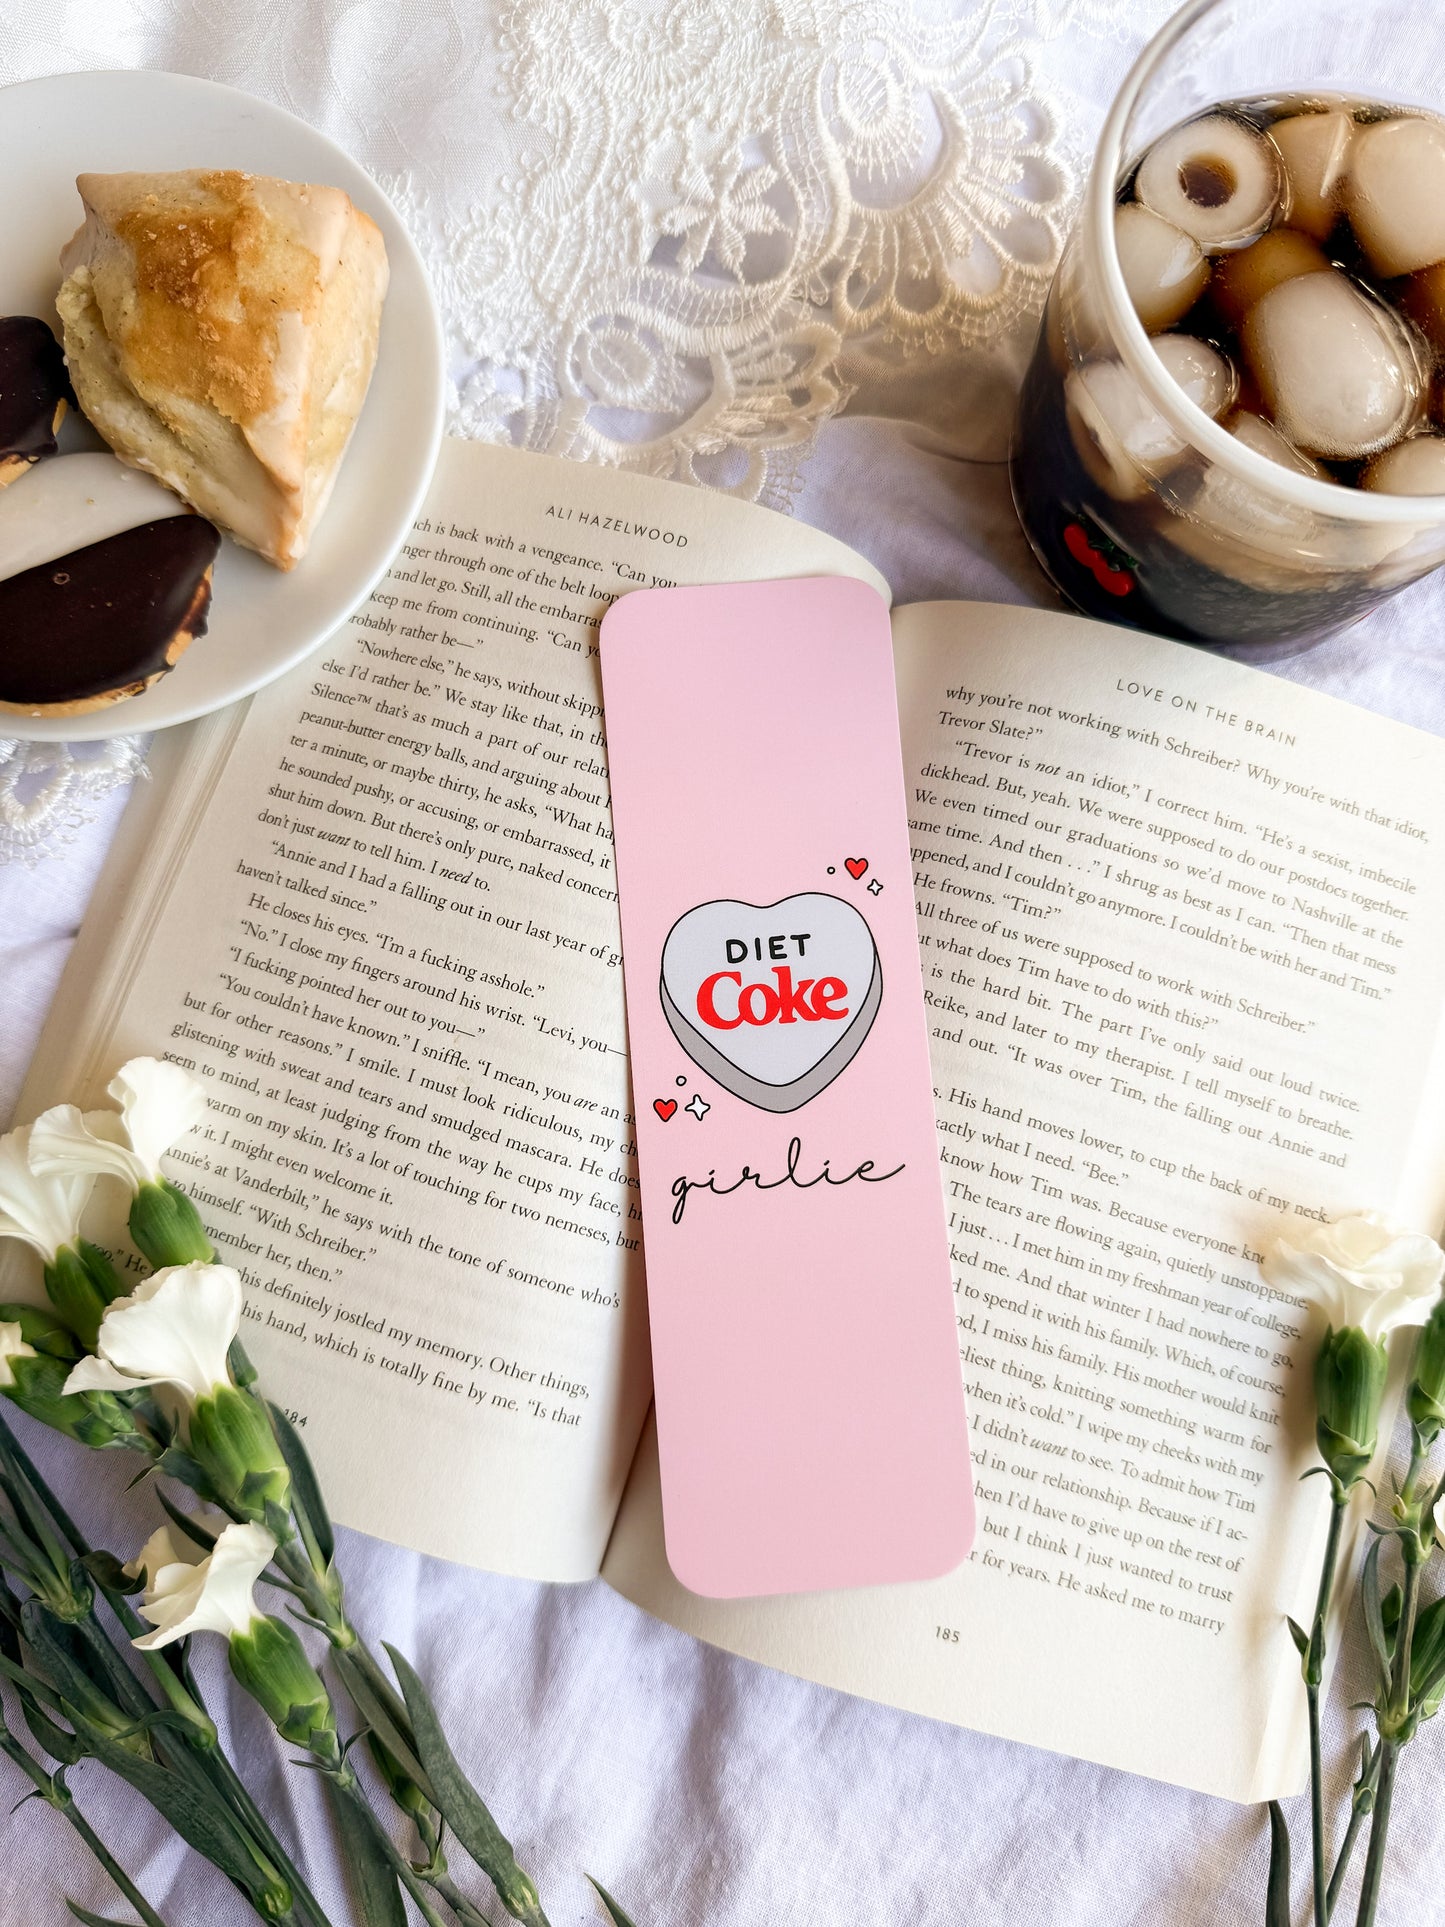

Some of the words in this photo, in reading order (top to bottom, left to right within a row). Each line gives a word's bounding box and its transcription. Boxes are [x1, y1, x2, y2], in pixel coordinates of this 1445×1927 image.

[434, 521, 445, 534] is
[449, 523, 478, 542] back
[485, 534, 514, 550] with
[518, 543, 526, 553] a
[532, 546, 603, 571] vengeance.
[611, 560, 645, 582] “Can
[545, 505, 572, 520] ALI
[578, 511, 687, 547] HAZELWOOD
[357, 639, 418, 665] “Nowhere
[419, 654, 454, 673] else,”
[454, 661, 471, 678] he
[472, 672, 501, 690] says,
[507, 680, 560, 704] without
[1116, 678, 1163, 702] LOVE
[1171, 695, 1197, 712] ON
[1205, 705, 1237, 726] THE
[1244, 719, 1295, 746] BRAIN
[298, 711, 385, 740] peanut-butter
[386, 734, 432, 757] energy
[434, 742, 468, 767] balls,
[471, 759, 500, 773] and
[501, 768, 558, 795] arguing
[560, 782, 601, 805] about
[938, 710, 985, 730] Trevor
[988, 719, 1043, 740] Slate?”
[946, 685, 975, 705] why
[977, 693, 1023, 710] you’re
[1026, 703, 1052, 717] not
[1058, 710, 1122, 738] working
[1127, 728, 1159, 746] with
[1163, 736, 1240, 772] Schreiber?
[1247, 763, 1280, 790] Why
[1282, 781, 1325, 803] you’re
[1329, 797, 1359, 816] with
[1364, 807, 1392, 828] that
[1394, 817, 1428, 844] idiot,
[257, 808, 290, 828] don’t
[289, 817, 316, 836] just
[316, 830, 351, 846] want
[353, 839, 366, 851] to
[369, 844, 392, 859] tell
[393, 848, 425, 870] him.
[430, 859, 438, 873] I
[438, 868, 473, 884] need
[474, 877, 490, 891] to.
[278, 756, 295, 772] he
[297, 766, 353, 788] sounded
[351, 782, 394, 804] pushy,
[398, 795, 415, 807] or
[416, 801, 478, 830] accusing,
[483, 821, 499, 833] or
[502, 827, 594, 866] embarrassed,
[600, 853, 612, 870] it
[920, 762, 989, 788] dickhead.
[995, 777, 1026, 799] But,
[1030, 790, 1070, 808] yeah.
[1078, 797, 1102, 816] We
[1107, 810, 1142, 829] were
[1146, 823, 1215, 852] supposed
[1218, 845, 1232, 858] to
[1236, 849, 1255, 866] do
[1259, 860, 1285, 875] our
[1287, 870, 1347, 898] postdocs
[1351, 892, 1408, 921] together.
[236, 858, 282, 885] haven’t
[284, 877, 329, 899] talked
[329, 890, 377, 912] since.”
[913, 871, 936, 889] He
[939, 878, 994, 904] frowns.
[1002, 893, 1061, 919] “Tim?”
[230, 945, 242, 962] “I
[243, 951, 298, 984] fucking
[297, 974, 355, 999] pointed
[355, 988, 381, 1008] her
[383, 1003, 408, 1018] out
[411, 1010, 426, 1023] to
[247, 892, 270, 911] He
[272, 901, 311, 924] closes
[312, 912, 334, 931] his
[337, 926, 368, 943] eyes.
[376, 932, 404, 955] “I’m
[407, 949, 416, 959] a
[420, 948, 477, 982] fucking
[479, 972, 544, 997] asshole.”
[726, 933, 811, 964] DIET
[696, 966, 849, 1030] Coke
[170, 1021, 240, 1058] glistening
[245, 1048, 275, 1067] with
[280, 1061, 321, 1082] sweat
[324, 1076, 354, 1093] and
[358, 1086, 393, 1107] tears
[396, 1101, 427, 1118] and
[430, 1112, 501, 1143] smudged
[505, 1137, 571, 1167] mascara.
[579, 1157, 604, 1177] He
[608, 1167, 640, 1189] does
[923, 989, 968, 1018] Reike,
[975, 1010, 1006, 1026] and
[1011, 1015, 1047, 1038] later
[1053, 1032, 1068, 1045] to
[1074, 1040, 1099, 1058] my
[1105, 1046, 1174, 1080] therapist.
[1181, 1070, 1190, 1085] I
[1195, 1078, 1219, 1095] tell
[1223, 1089, 1276, 1112] myself
[1277, 1105, 1292, 1118] to
[1297, 1108, 1352, 1139] breathe.
[672, 1136, 905, 1224] girlie
[981, 1132, 1020, 1153] what
[1023, 1142, 1032, 1157] I
[1034, 1150, 1074, 1171] need.
[1082, 1160, 1128, 1186] “Bee.”
[949, 1180, 981, 1203] The
[985, 1196, 1022, 1217] tears
[1025, 1211, 1050, 1226] are
[1054, 1215, 1113, 1250] flowing
[1116, 1240, 1161, 1265] again,
[1166, 1256, 1216, 1283] quietly
[240, 1300, 263, 1321] his
[265, 1309, 306, 1342] hand,
[314, 1332, 358, 1358] which
[362, 1346, 375, 1363] is
[379, 1356, 428, 1385] totally
[432, 1371, 463, 1393] fine
[467, 1381, 486, 1404] by
[491, 1394, 518, 1411] me.
[528, 1399, 546, 1417] “Is
[551, 1406, 580, 1425] that
[263, 1277, 332, 1317] definitely
[333, 1303, 385, 1333] jostled
[387, 1327, 412, 1346] my
[415, 1336, 482, 1370] memory.
[489, 1356, 536, 1382] Other
[539, 1371, 589, 1399] things,
[1001, 1359, 1046, 1389] thing,
[1052, 1373, 1115, 1411] knitting
[1118, 1400, 1198, 1436] something
[1203, 1424, 1244, 1446] warm
[1250, 1434, 1272, 1453] for
[982, 1515, 1009, 1538] but
[1013, 1525, 1021, 1541] I
[1026, 1530, 1067, 1555] think
[1074, 1542, 1081, 1559] I
[1086, 1546, 1113, 1568] just
[1119, 1560, 1173, 1584] wanted
[1178, 1576, 1192, 1590] to
[1197, 1582, 1233, 1602] trust
[935, 1625, 960, 1642] 185
